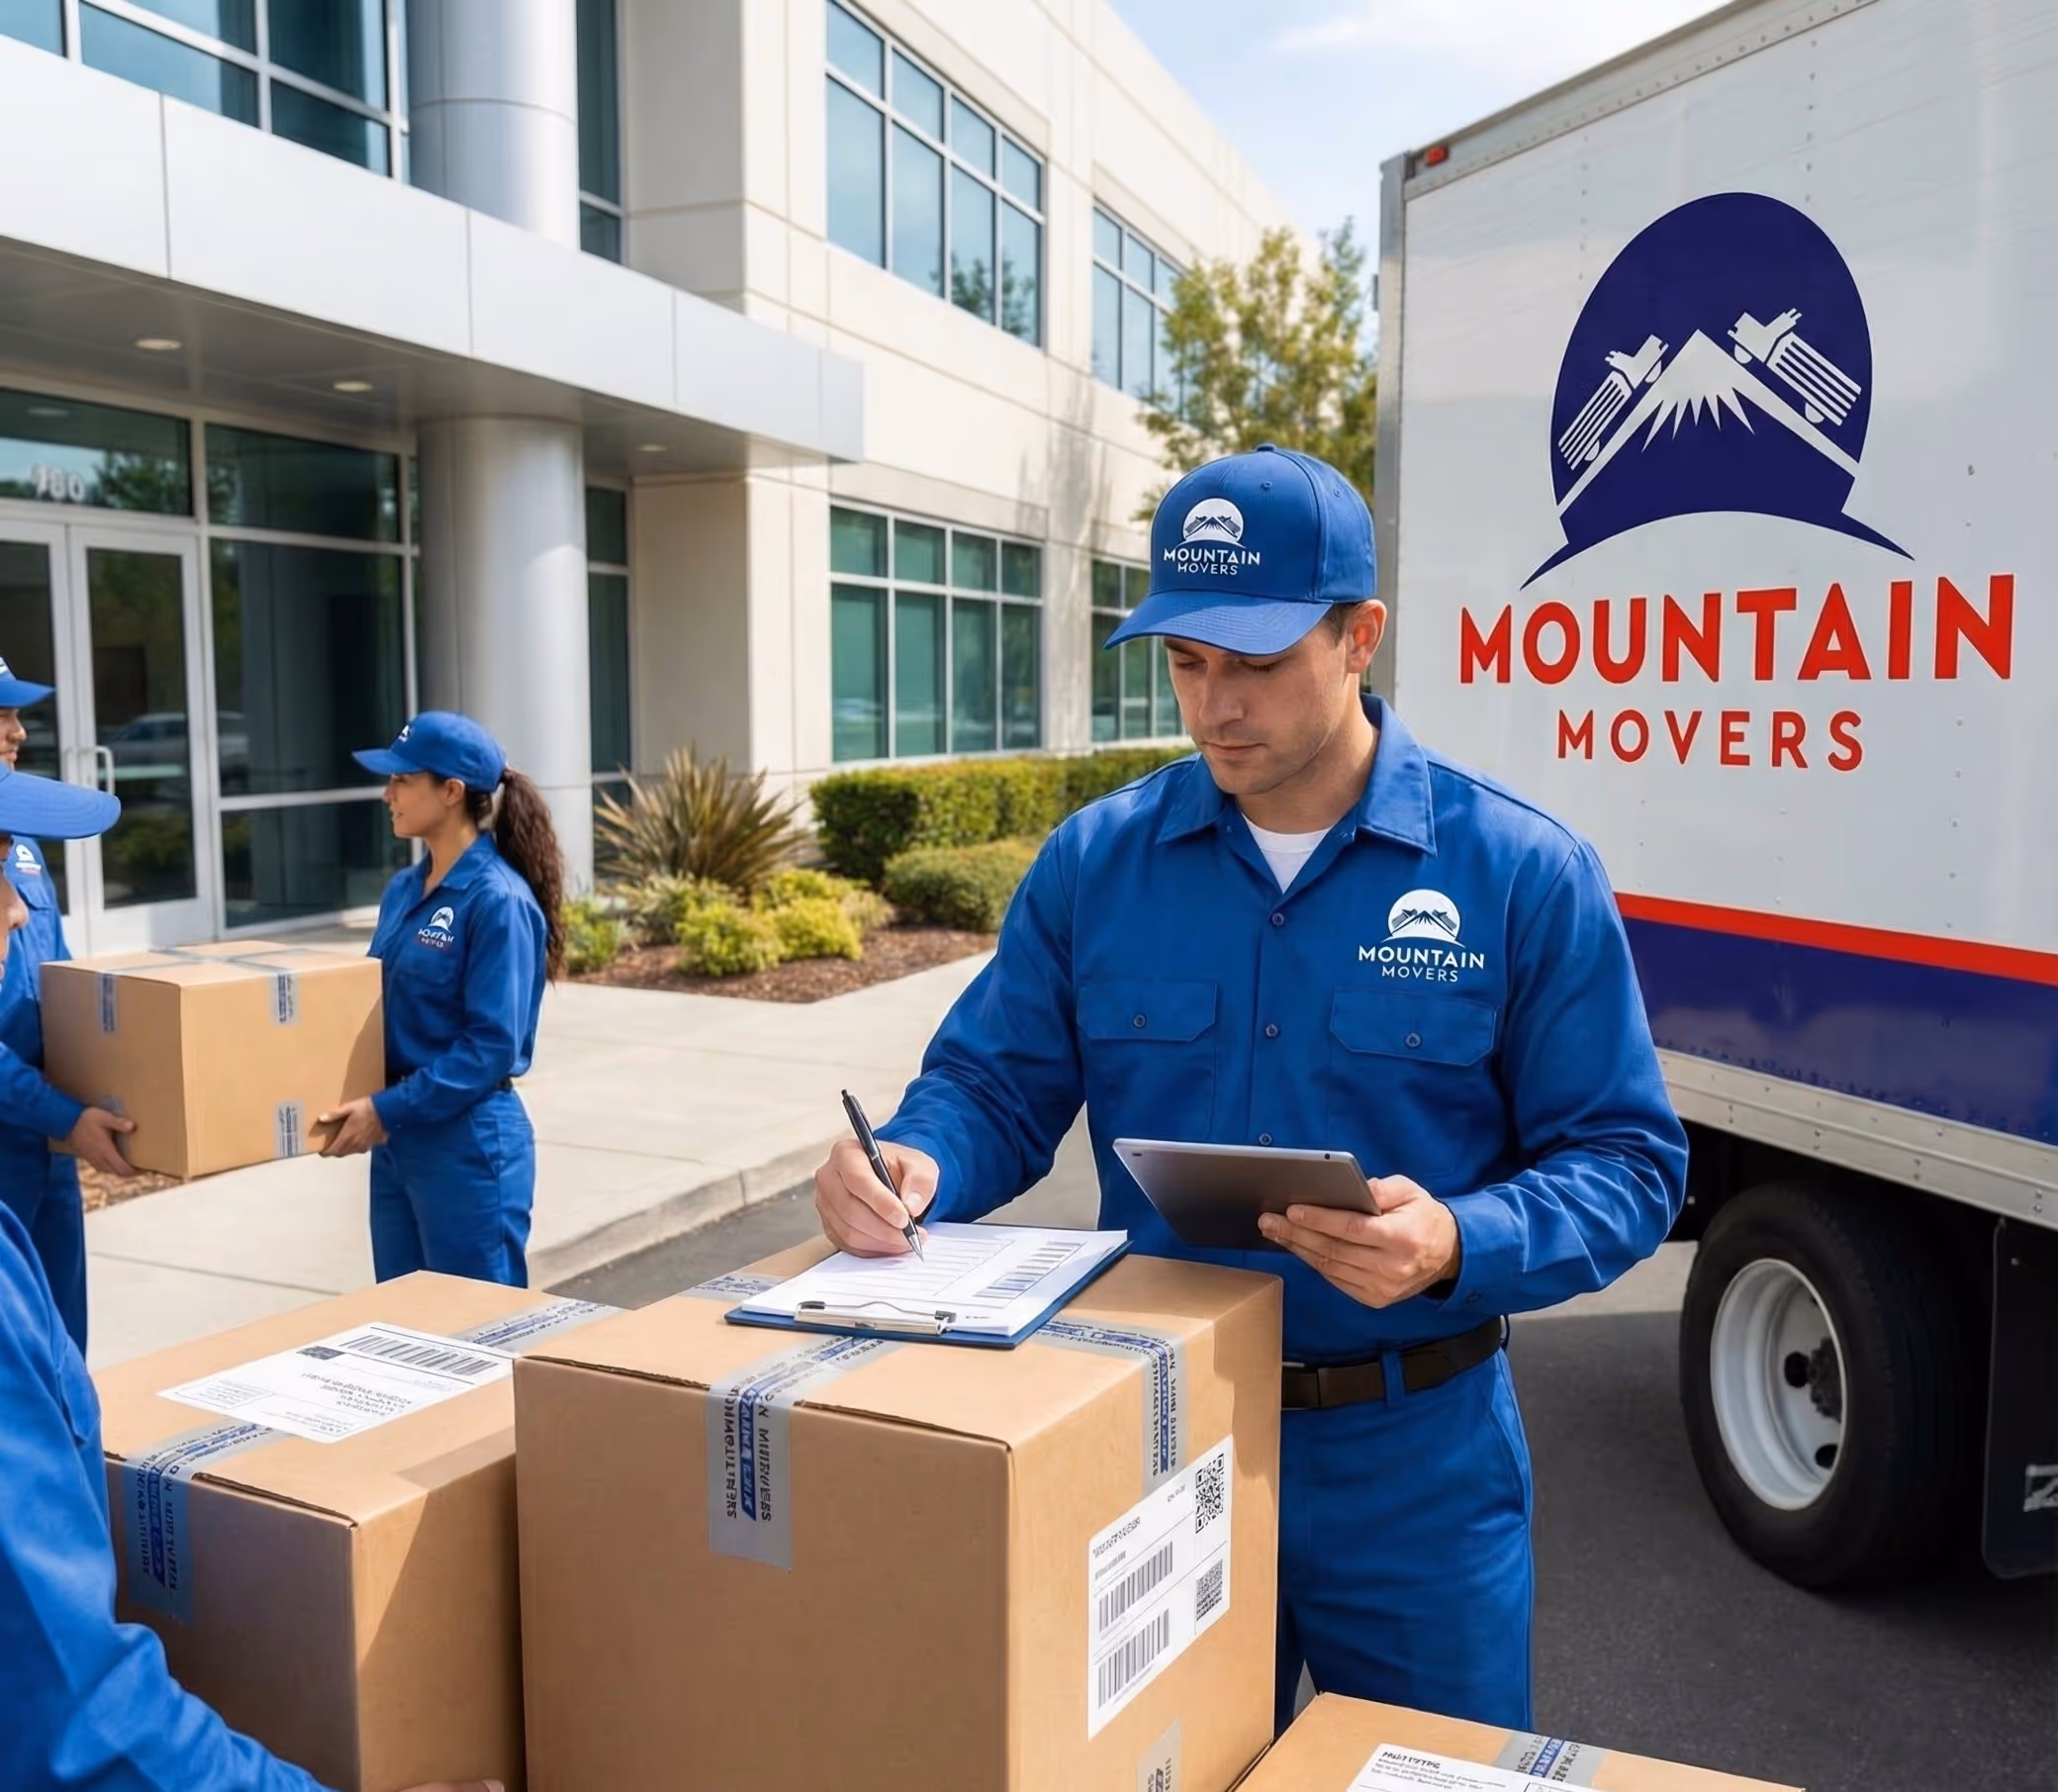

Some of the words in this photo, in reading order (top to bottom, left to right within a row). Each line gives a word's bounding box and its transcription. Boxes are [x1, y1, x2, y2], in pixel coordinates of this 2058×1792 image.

[1164, 547, 1261, 565] MOUNTAIN
[1177, 562, 1238, 575] MOVERS
[1459, 574, 2014, 685] MOUNTAIN
[1558, 709, 1863, 771] MOVERS
[1358, 945, 1484, 969] MOUNTAIN
[1382, 966, 1458, 982] MOVERS
